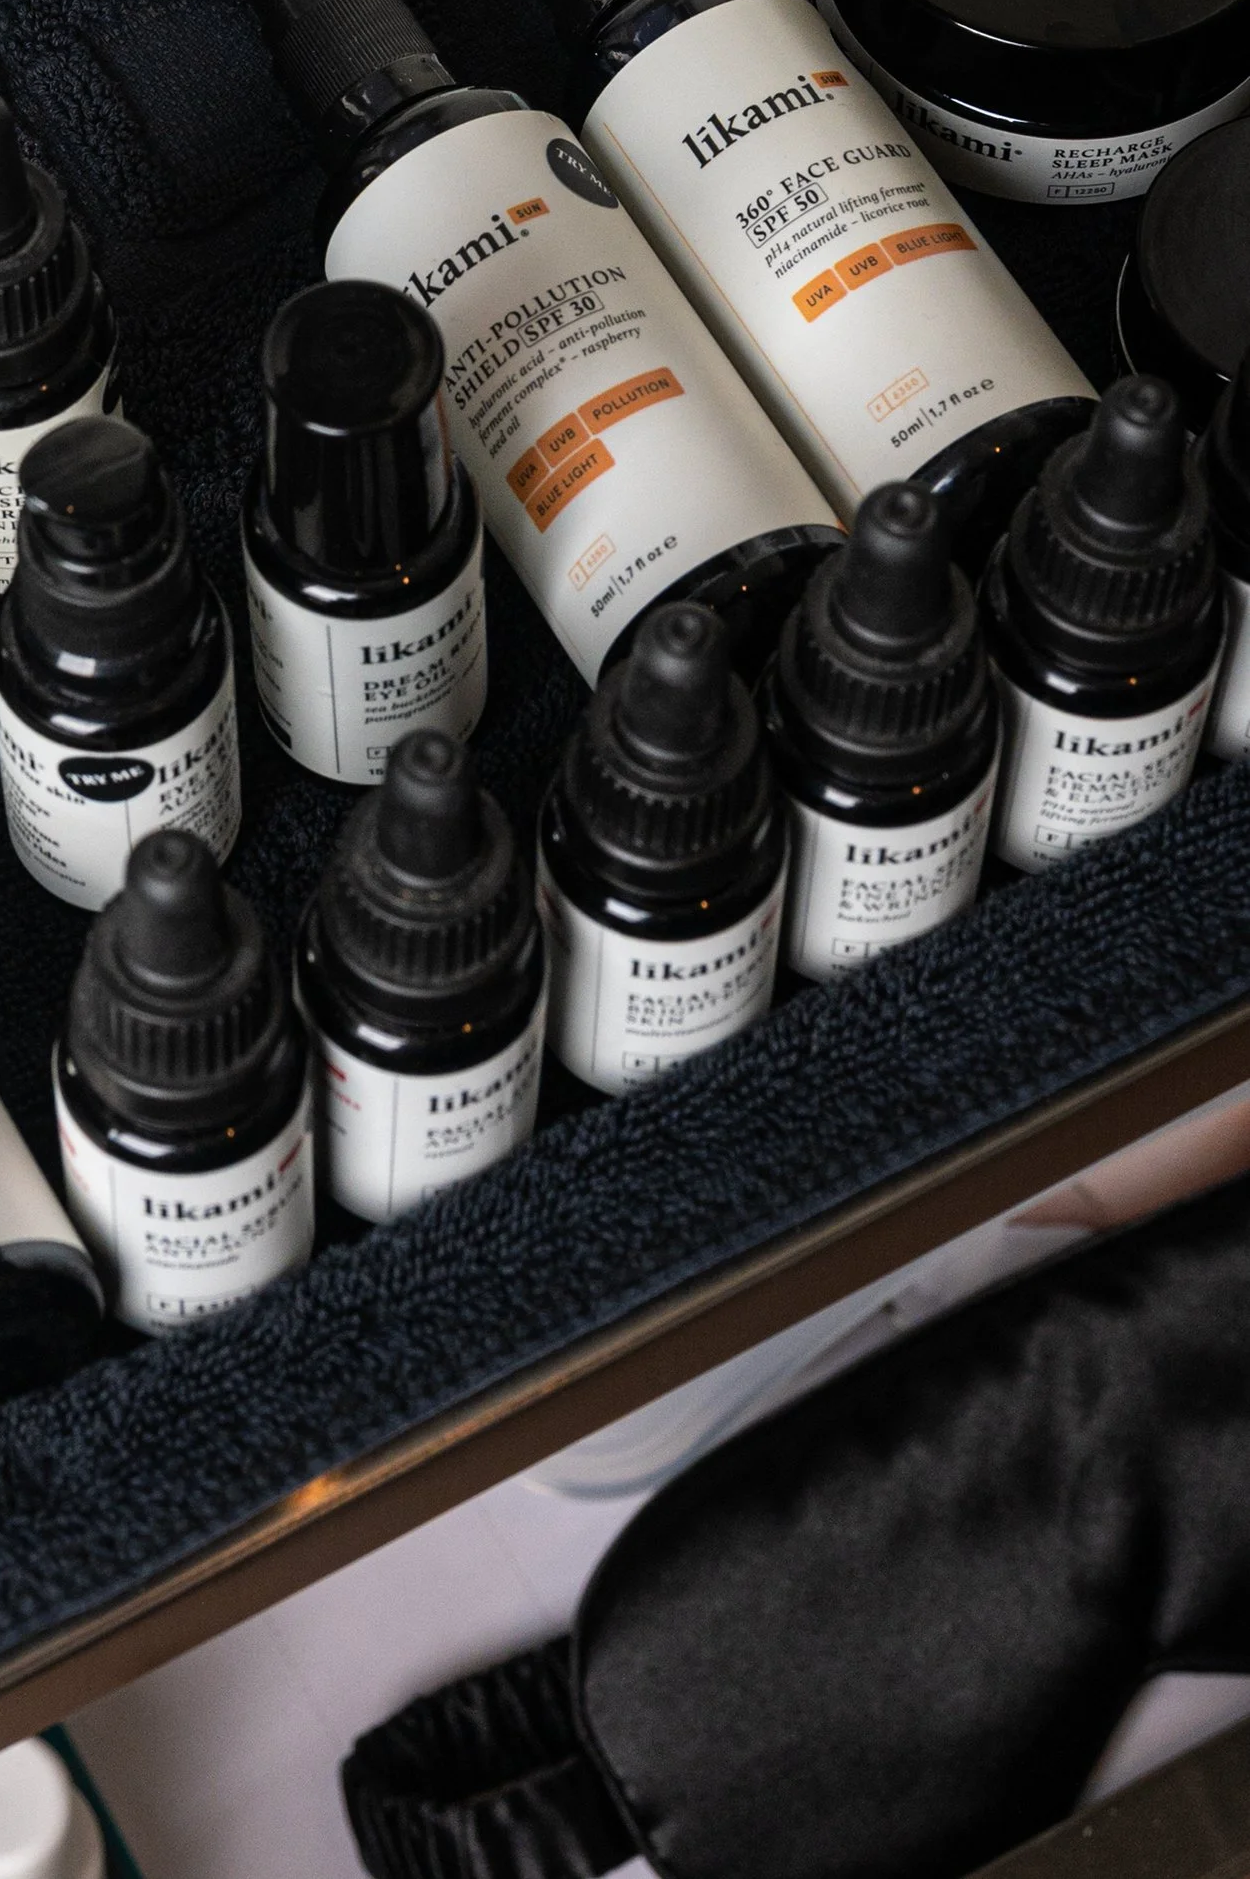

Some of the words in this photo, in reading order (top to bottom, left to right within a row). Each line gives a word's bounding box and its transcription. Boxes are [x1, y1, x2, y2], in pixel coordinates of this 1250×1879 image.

[556, 147, 587, 174] TRY
[1052, 157, 1113, 169] SLEEP
[1120, 141, 1174, 165] MASK
[1055, 135, 1165, 158] RECHARGE
[736, 189, 773, 229] 360°
[780, 156, 840, 195] FACE
[843, 143, 911, 165] GUARD
[753, 207, 790, 242] SPF
[794, 190, 819, 211] 50
[765, 243, 790, 268] pH4
[791, 206, 838, 245] natural
[839, 189, 879, 217] lifting
[774, 224, 848, 278] niacinamide
[860, 202, 904, 223] licorice
[806, 284, 833, 307] UVA
[849, 256, 879, 276] UVB
[896, 237, 931, 254] BLUE
[445, 265, 627, 394] ANTI-POLLUTION
[454, 338, 521, 411] SHIELD
[523, 309, 565, 343] SPF
[572, 294, 597, 318] 30
[581, 325, 642, 359] raspberry
[469, 374, 518, 429] hyaluronic
[519, 350, 545, 377] acid
[558, 308, 647, 351] anti-pollution
[592, 378, 671, 420] POLLUTION
[517, 463, 538, 488] UVA
[549, 427, 577, 453] UVB
[890, 418, 924, 448] 50ml
[536, 484, 562, 517] BLUE
[563, 452, 599, 487] LIGHT
[591, 585, 616, 620] 50ml
[364, 658, 445, 691] DREAM
[65, 771, 108, 786] TRY
[110, 764, 146, 782] ME
